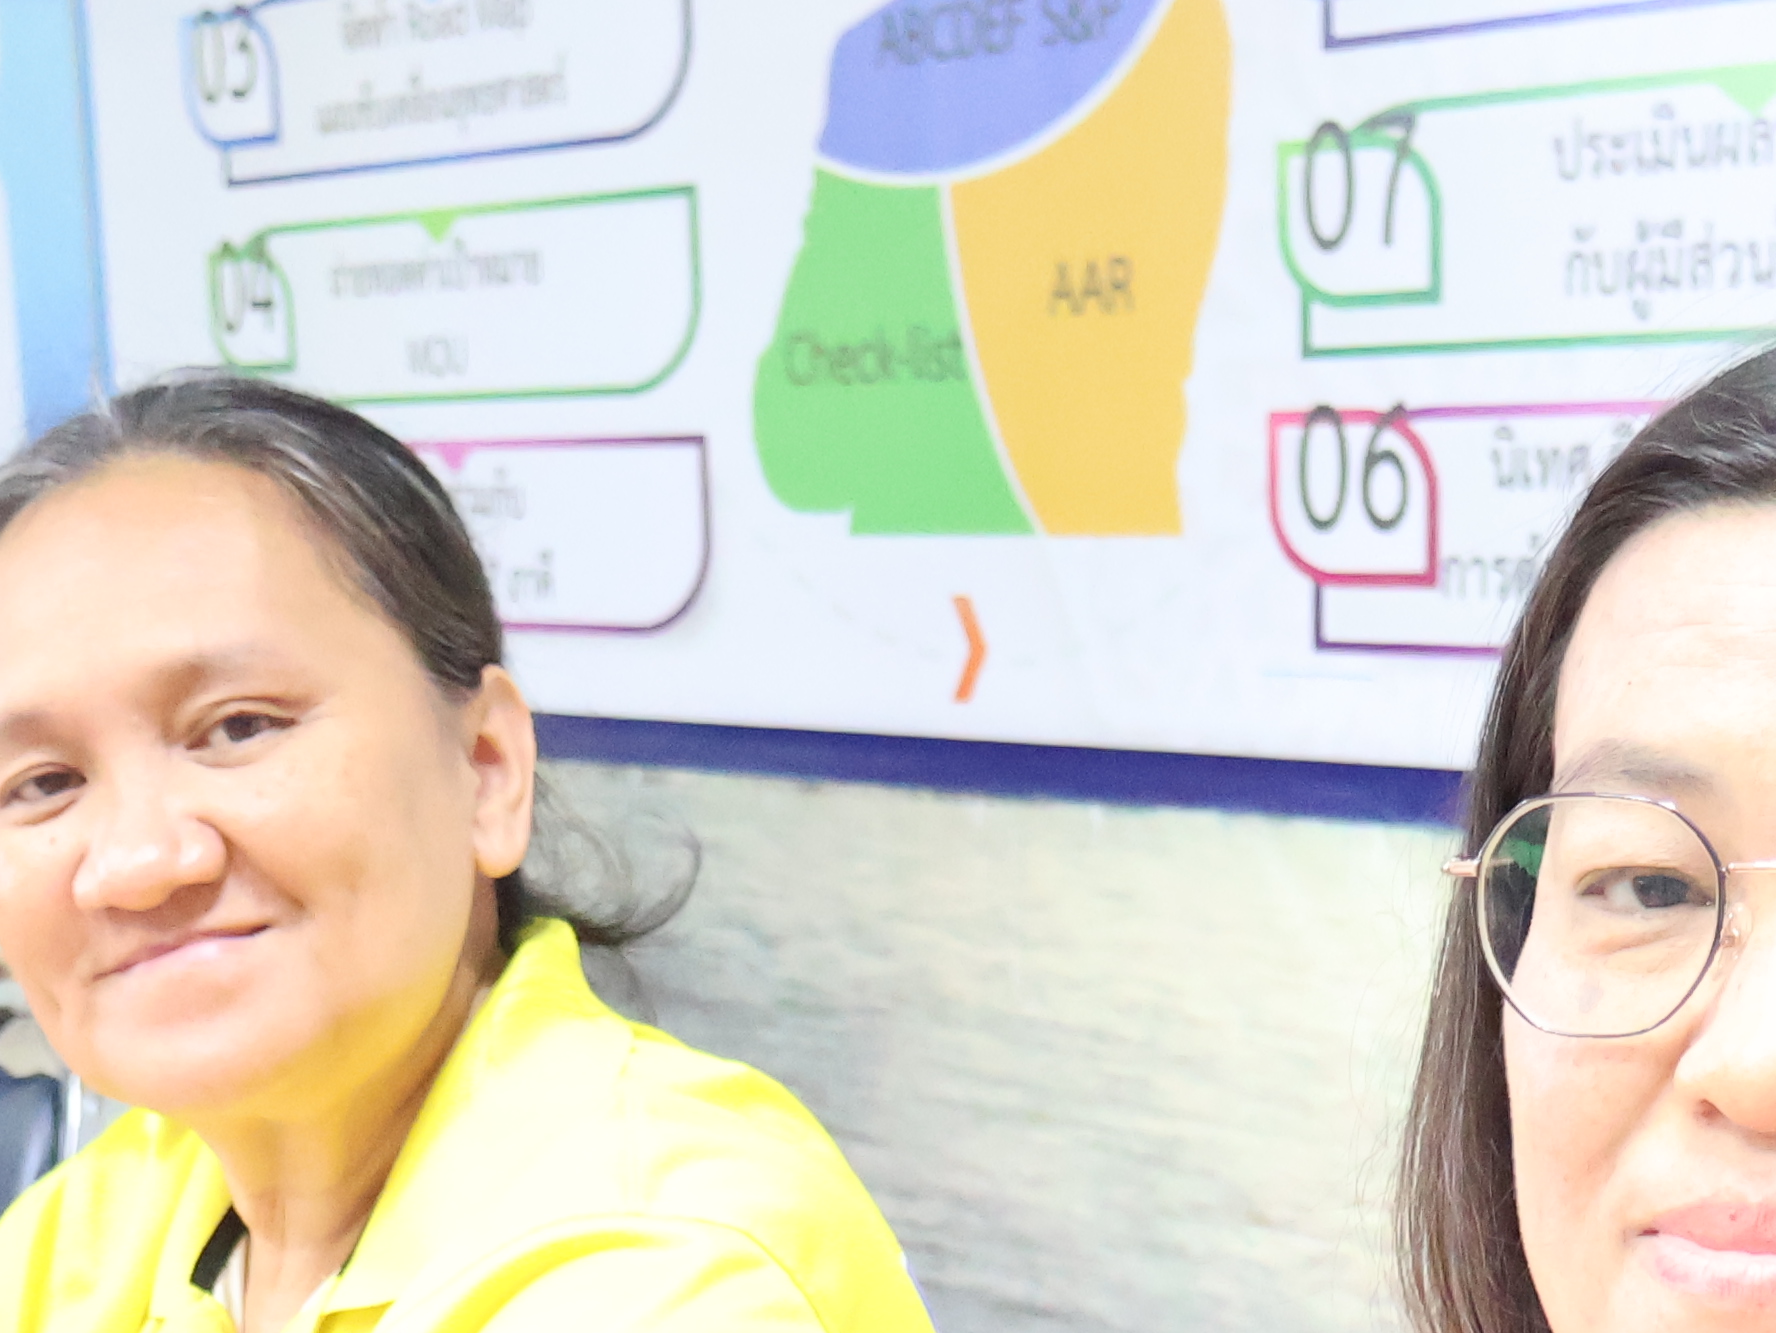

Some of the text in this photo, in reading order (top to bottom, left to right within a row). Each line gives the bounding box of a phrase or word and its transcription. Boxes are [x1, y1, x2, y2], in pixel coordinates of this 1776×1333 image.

[191, 6, 258, 104] 03
[1301, 110, 1416, 251] 07
[214, 238, 277, 334] 04
[1046, 255, 1136, 317] AAR
[783, 324, 968, 388] Check-list
[1299, 403, 1408, 531] 06
